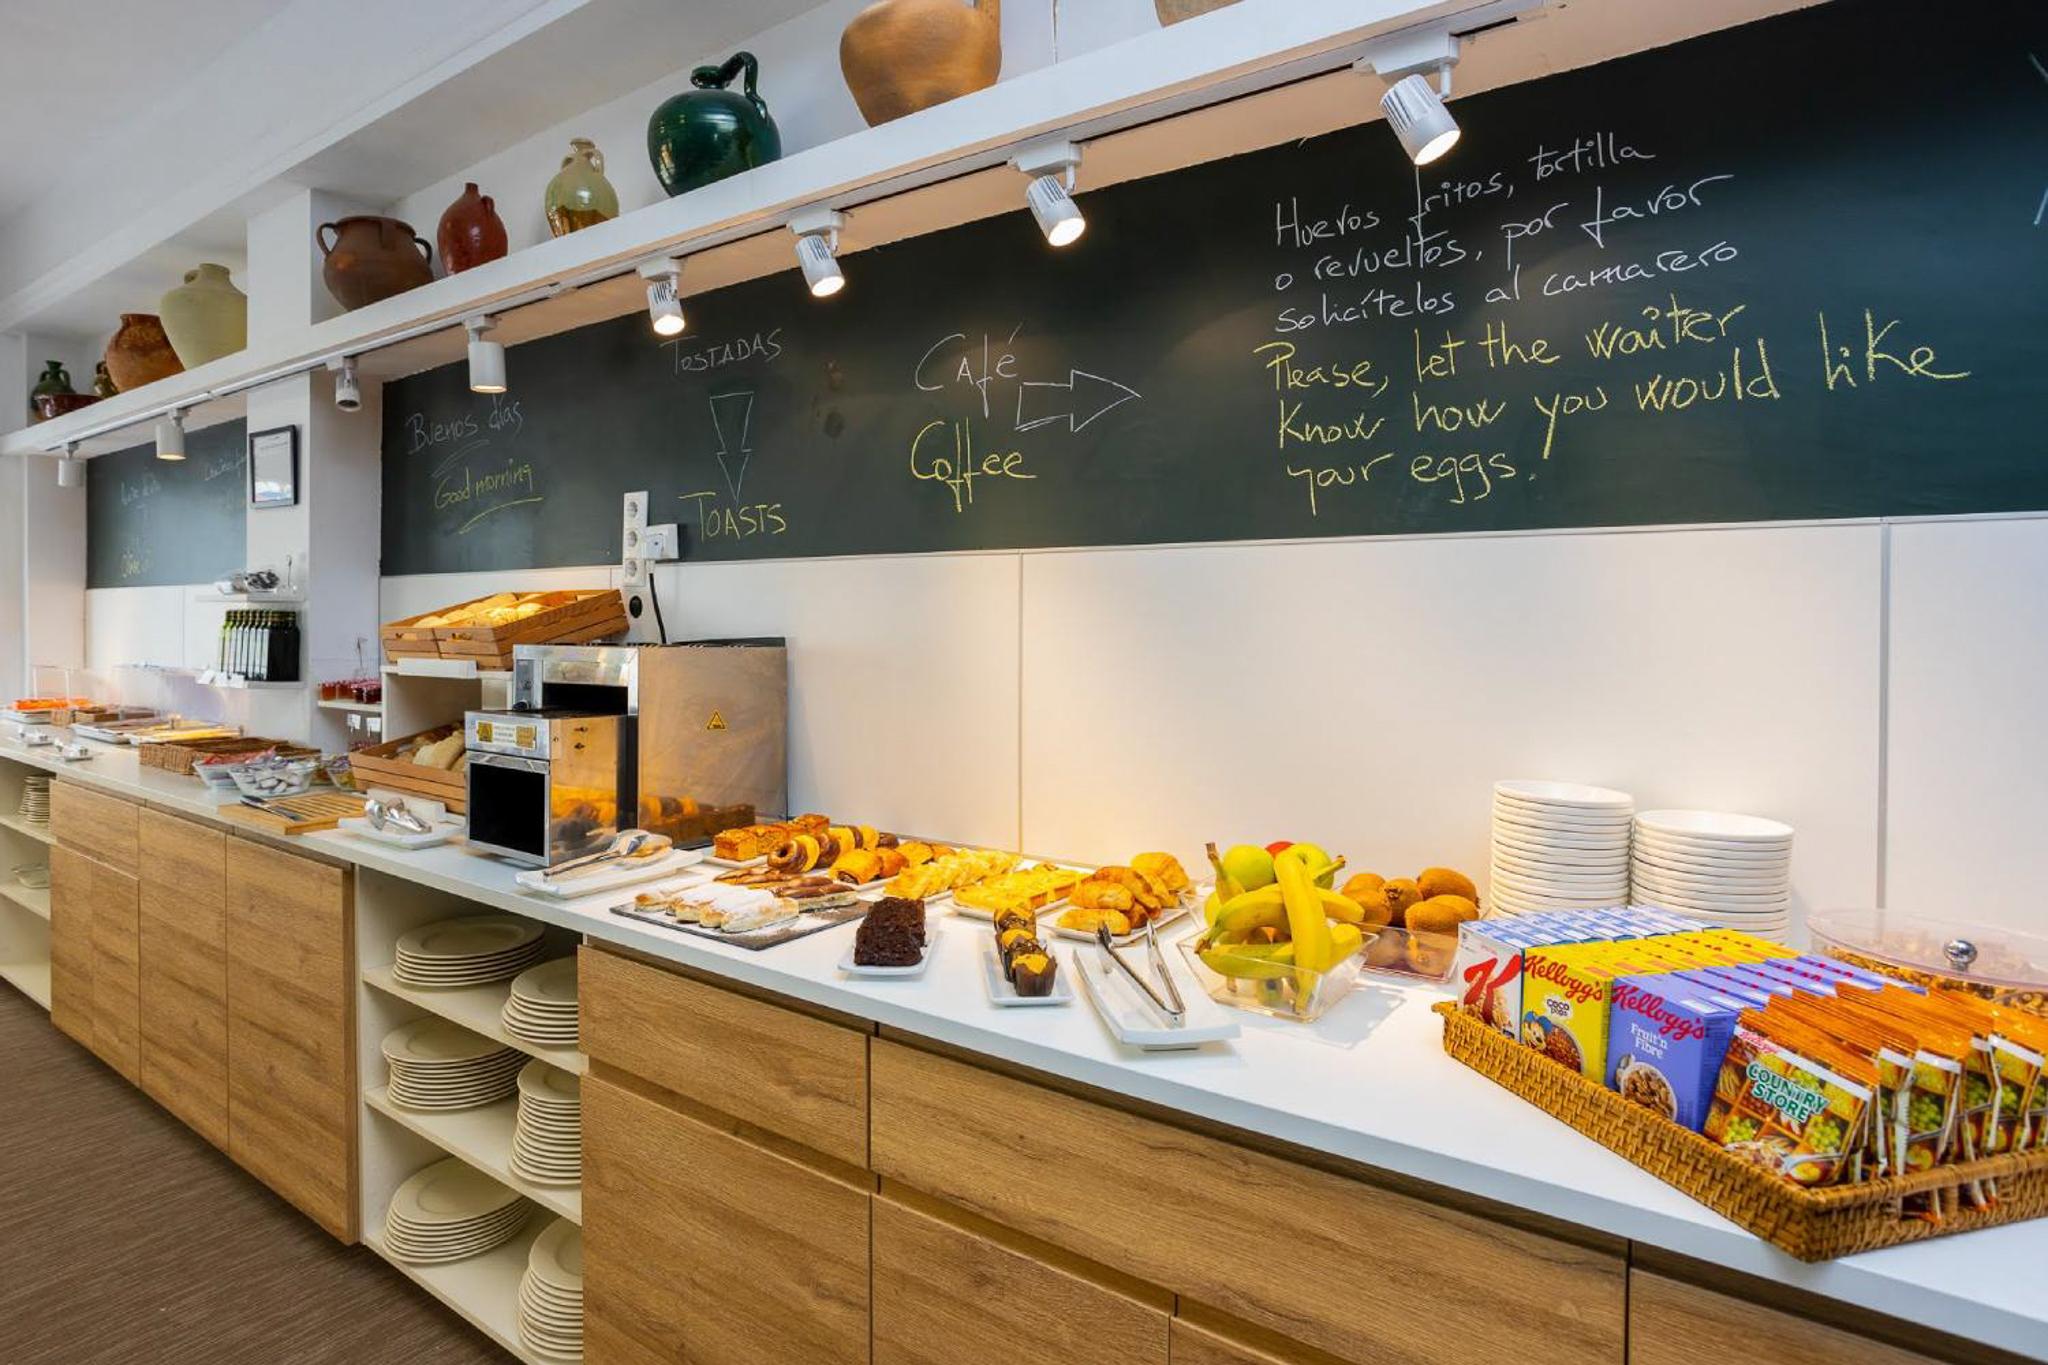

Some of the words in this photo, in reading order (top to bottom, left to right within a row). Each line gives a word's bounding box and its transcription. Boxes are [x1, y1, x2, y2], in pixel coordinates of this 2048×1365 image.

[1276, 197, 1380, 248] Huevos
[1528, 132, 1656, 181] tortilla
[1275, 273, 1293, 291] o
[1314, 230, 1483, 281] revueltos,
[1501, 202, 1569, 271] por
[1580, 174, 1735, 249] favor
[1485, 264, 1521, 304] al
[1543, 241, 1738, 296] camarero
[1253, 342, 1388, 399] Please,
[1414, 328, 1466, 383] let
[1478, 320, 1561, 368] the
[1586, 293, 1746, 359] waiter
[1412, 391, 1507, 432] how
[1534, 386, 1607, 460] you
[1635, 338, 1781, 411] would
[406, 412, 479, 455] Buenos
[434, 466, 471, 510] Good
[475, 458, 535, 497] morning
[911, 417, 1038, 514] Coffee
[1286, 452, 1394, 517] your
[678, 491, 787, 544] TOASTS
[1464, 954, 1522, 1025] K
[1525, 955, 1604, 1004] Kellogg's
[1612, 984, 1705, 1041] Kellogg's
[1635, 1036, 1664, 1059] Fibre
[1747, 1062, 1829, 1114] COUNTRY
[1753, 1083, 1810, 1122] STORE
